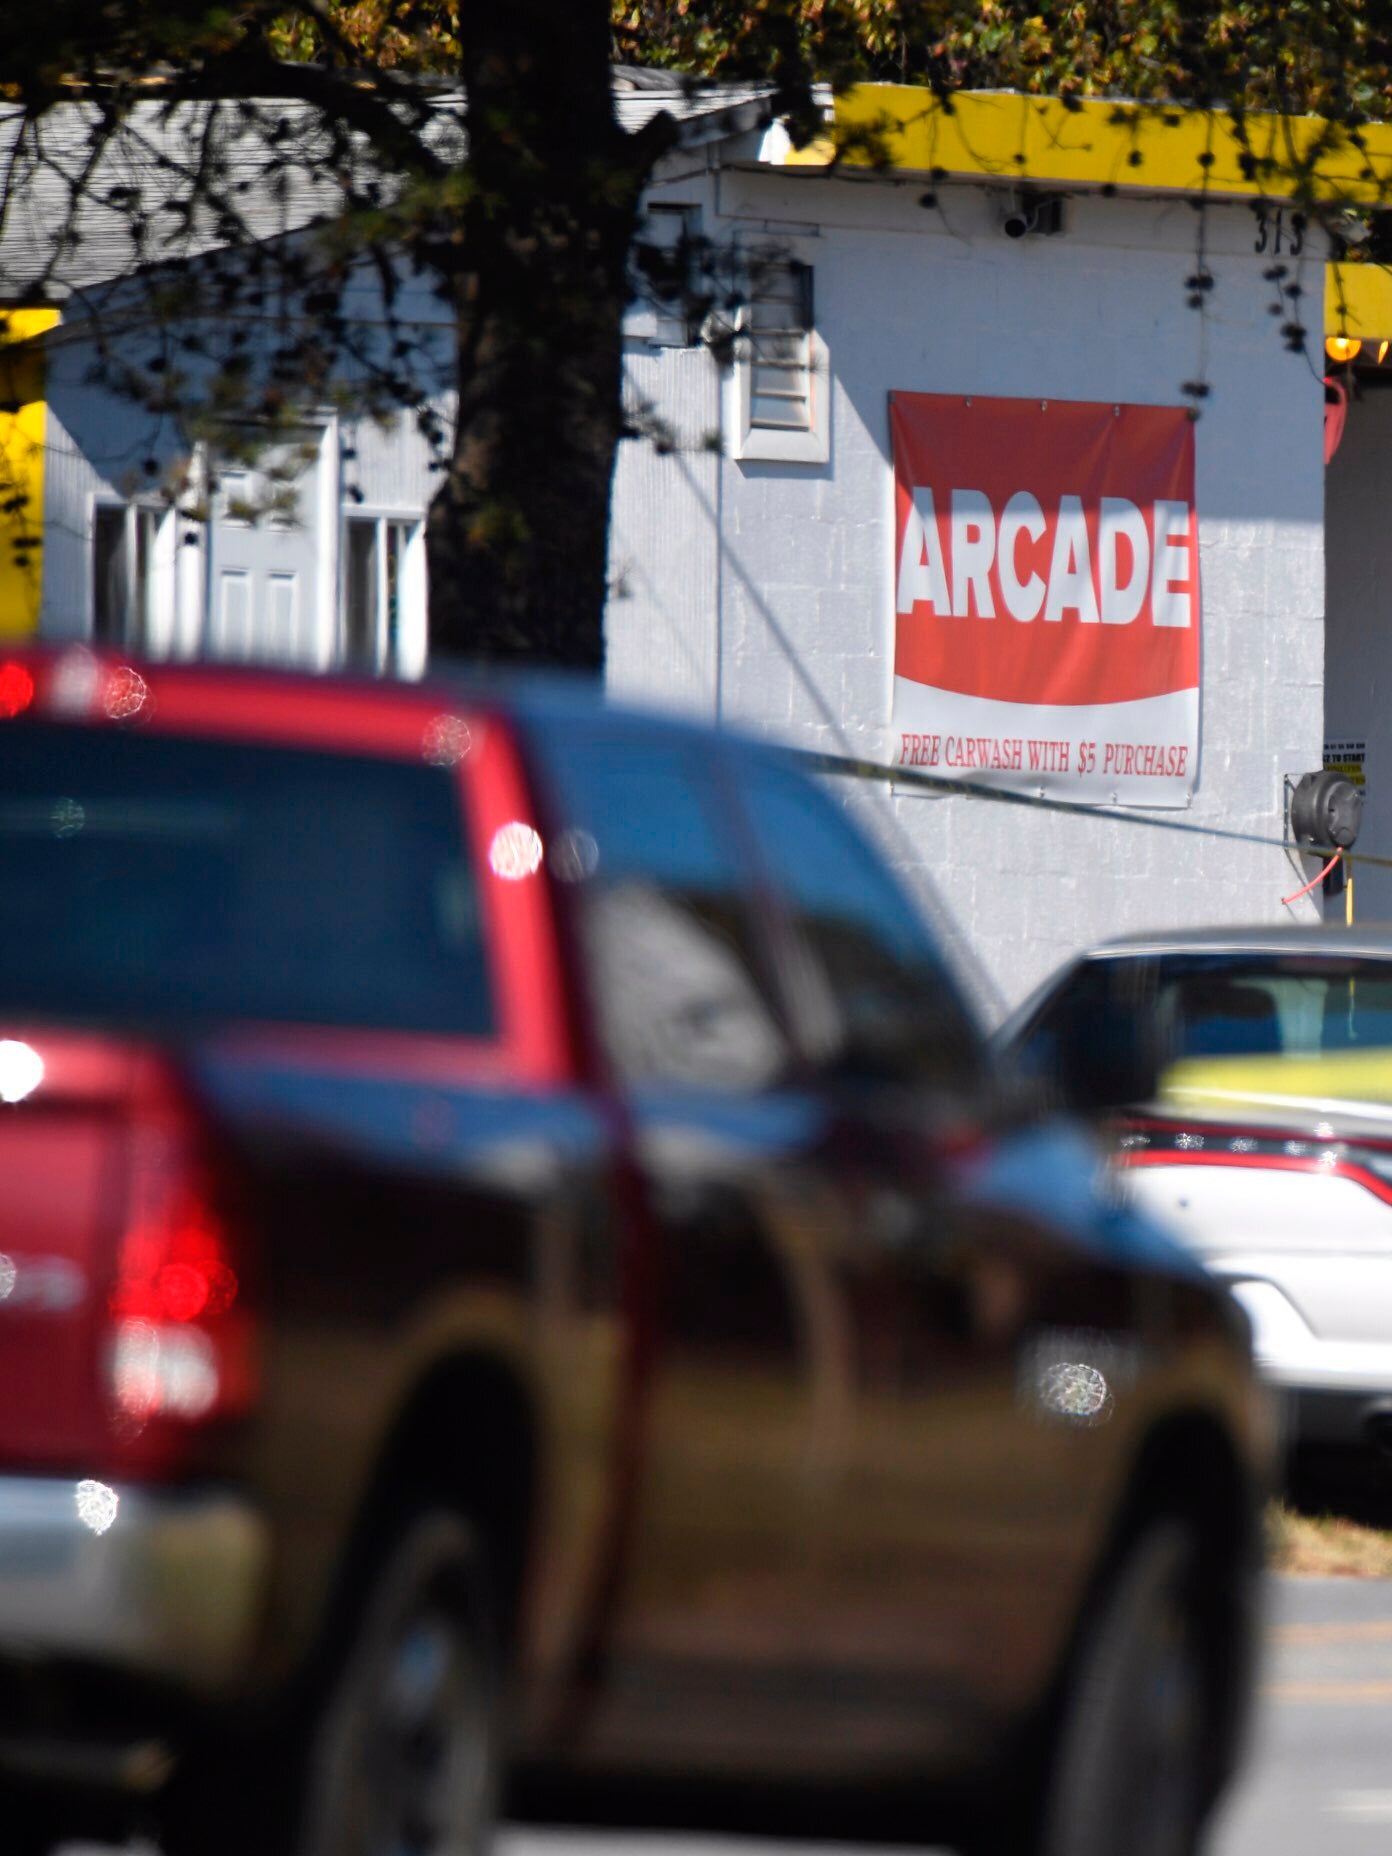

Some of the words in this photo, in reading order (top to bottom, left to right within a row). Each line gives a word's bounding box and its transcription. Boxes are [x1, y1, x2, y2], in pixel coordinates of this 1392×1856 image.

[896, 486, 1192, 628] ARCADE
[900, 734, 941, 766] FREE
[944, 736, 1023, 770] CARWASH
[1027, 740, 1070, 772] WITH
[1077, 740, 1096, 777] $5
[1102, 743, 1188, 777] PURCHASE
